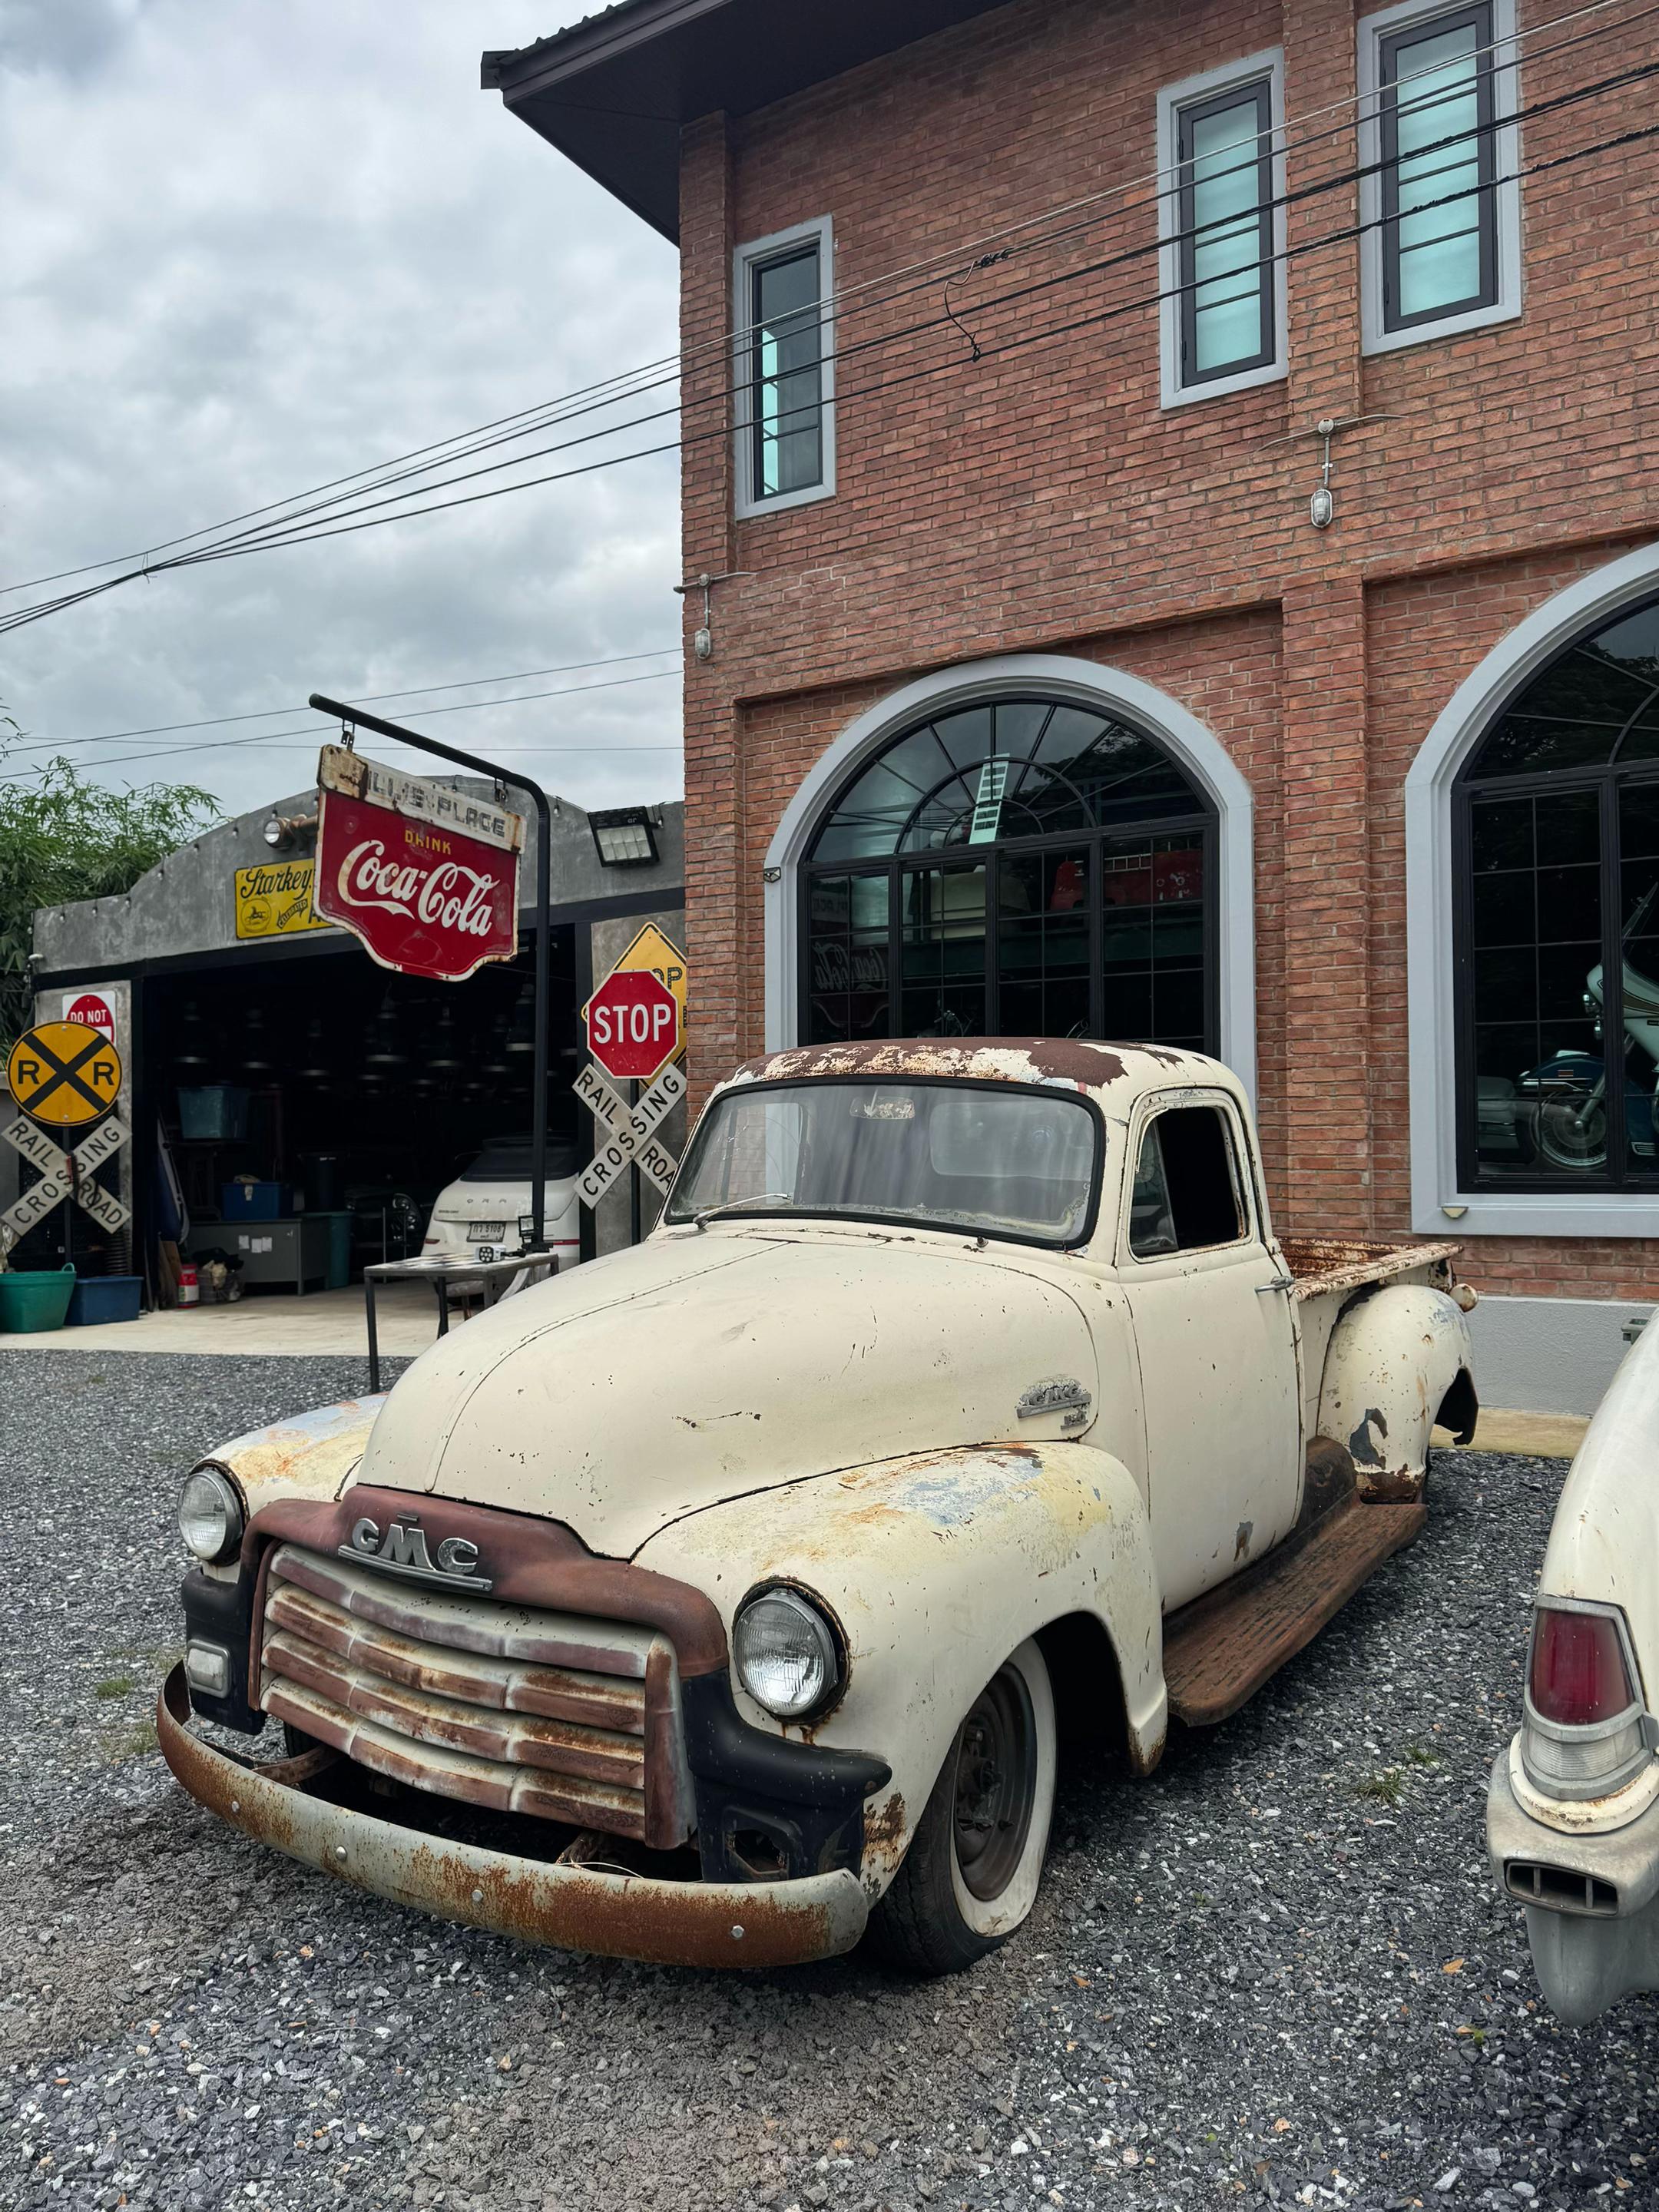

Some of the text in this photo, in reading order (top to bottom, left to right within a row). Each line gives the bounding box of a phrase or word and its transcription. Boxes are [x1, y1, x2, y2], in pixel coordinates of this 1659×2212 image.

[436, 796, 505, 838] PLACE
[404, 830, 452, 855] DRINK
[338, 839, 501, 936] Coca-Cola
[70, 1009, 107, 1023] DO NOT
[594, 1003, 671, 1044] STOP
[18, 1060, 114, 1085] R R
[577, 1070, 677, 1190] RAIL ROA
[583, 1075, 679, 1196] CROSSING
[9, 1121, 123, 1225] RAIL ROAD
[352, 1517, 479, 1574] GMC
